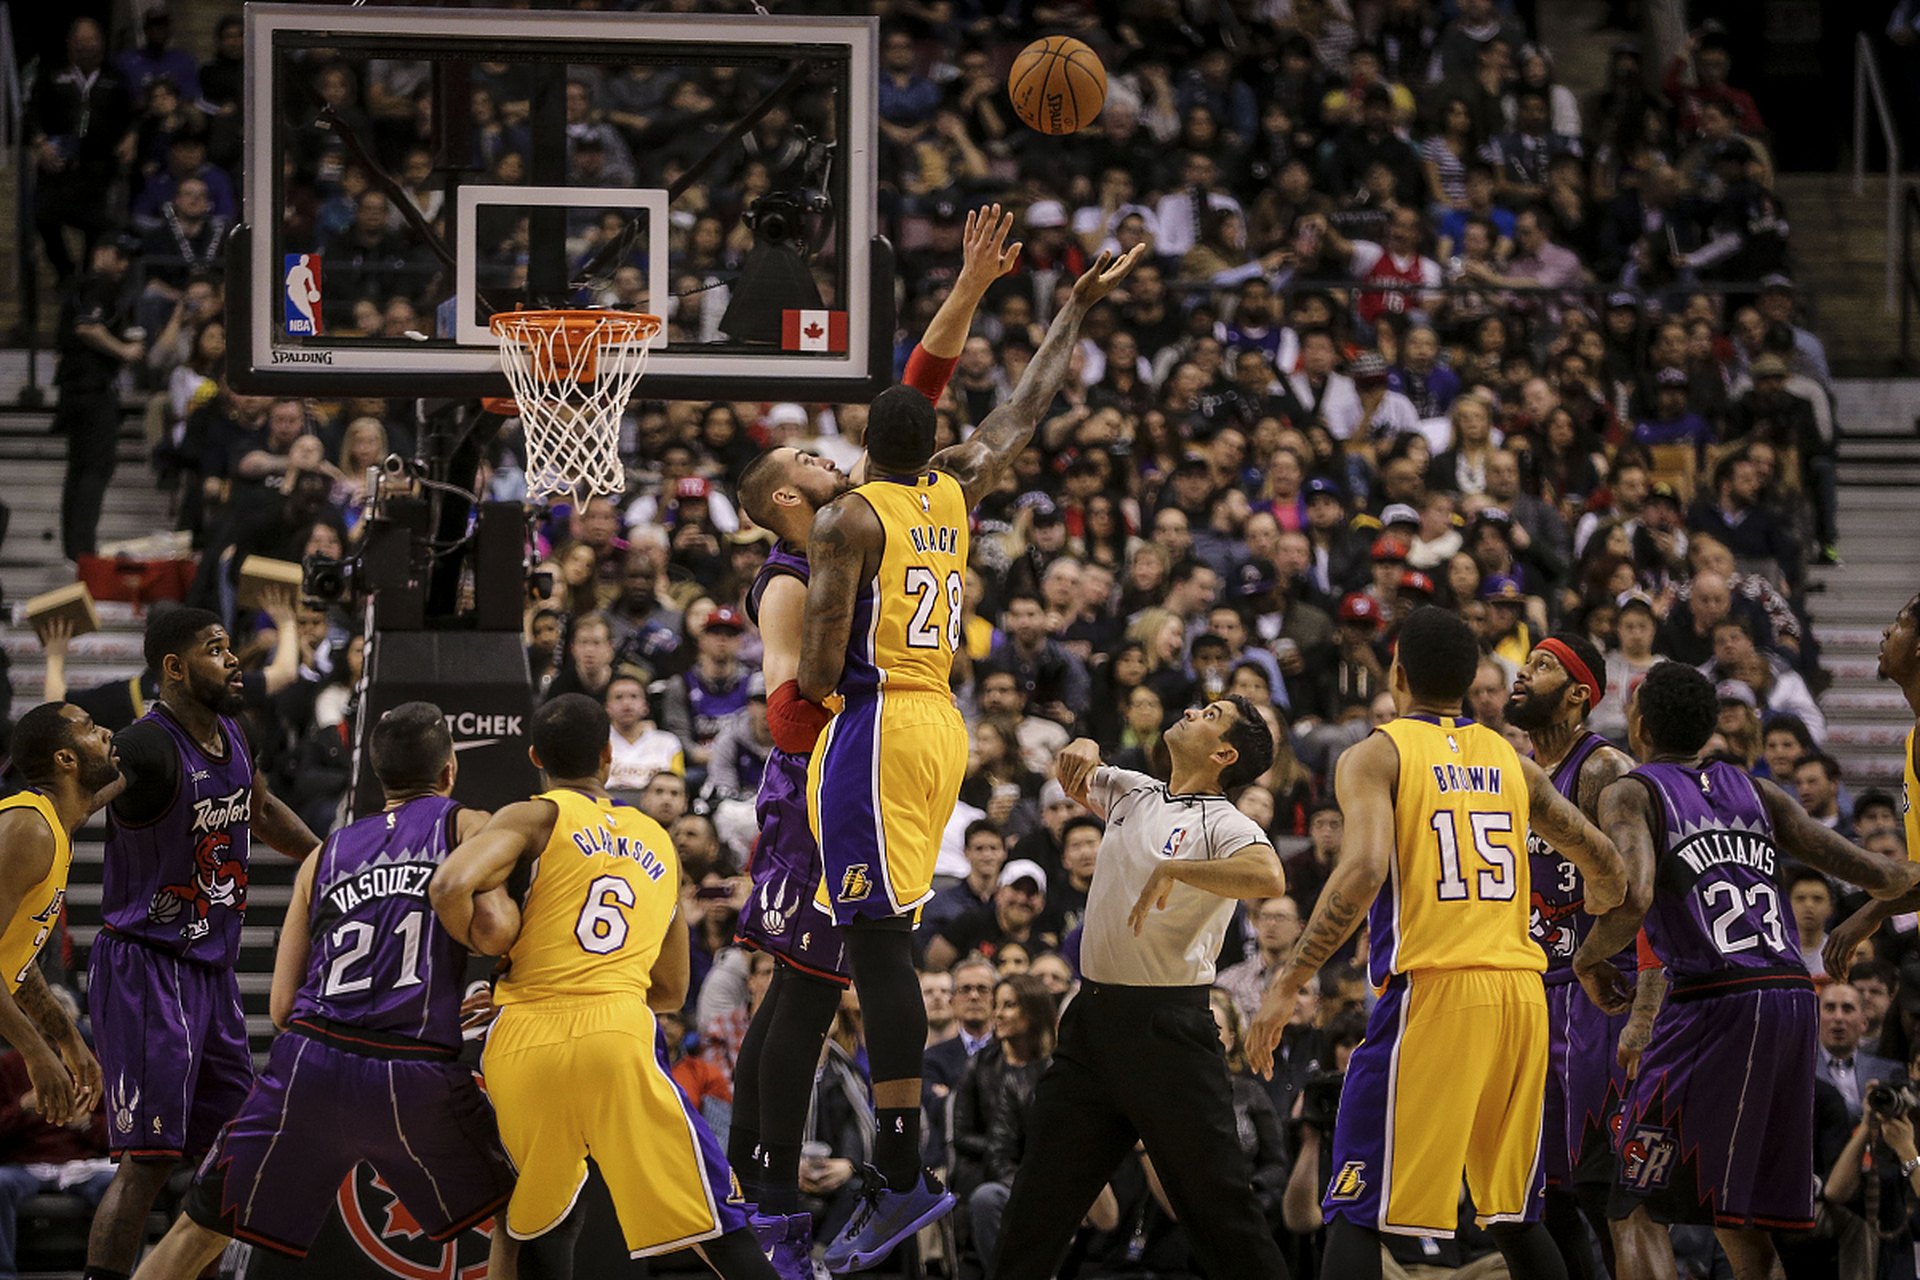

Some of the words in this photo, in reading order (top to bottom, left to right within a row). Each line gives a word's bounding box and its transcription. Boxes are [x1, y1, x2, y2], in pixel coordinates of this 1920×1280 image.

[288, 319, 312, 333] NBA
[271, 350, 333, 366] SPALDING
[909, 525, 958, 556] BLACK
[904, 566, 963, 654] 28
[1432, 764, 1502, 795] BROWN
[1430, 809, 1516, 901] 15
[1556, 861, 1577, 893] 3
[1677, 833, 1776, 876] WILLIAMS
[329, 864, 433, 914] VASQUEZ
[574, 873, 636, 956] 6
[1703, 880, 1786, 953] 23
[324, 910, 424, 997] 21
